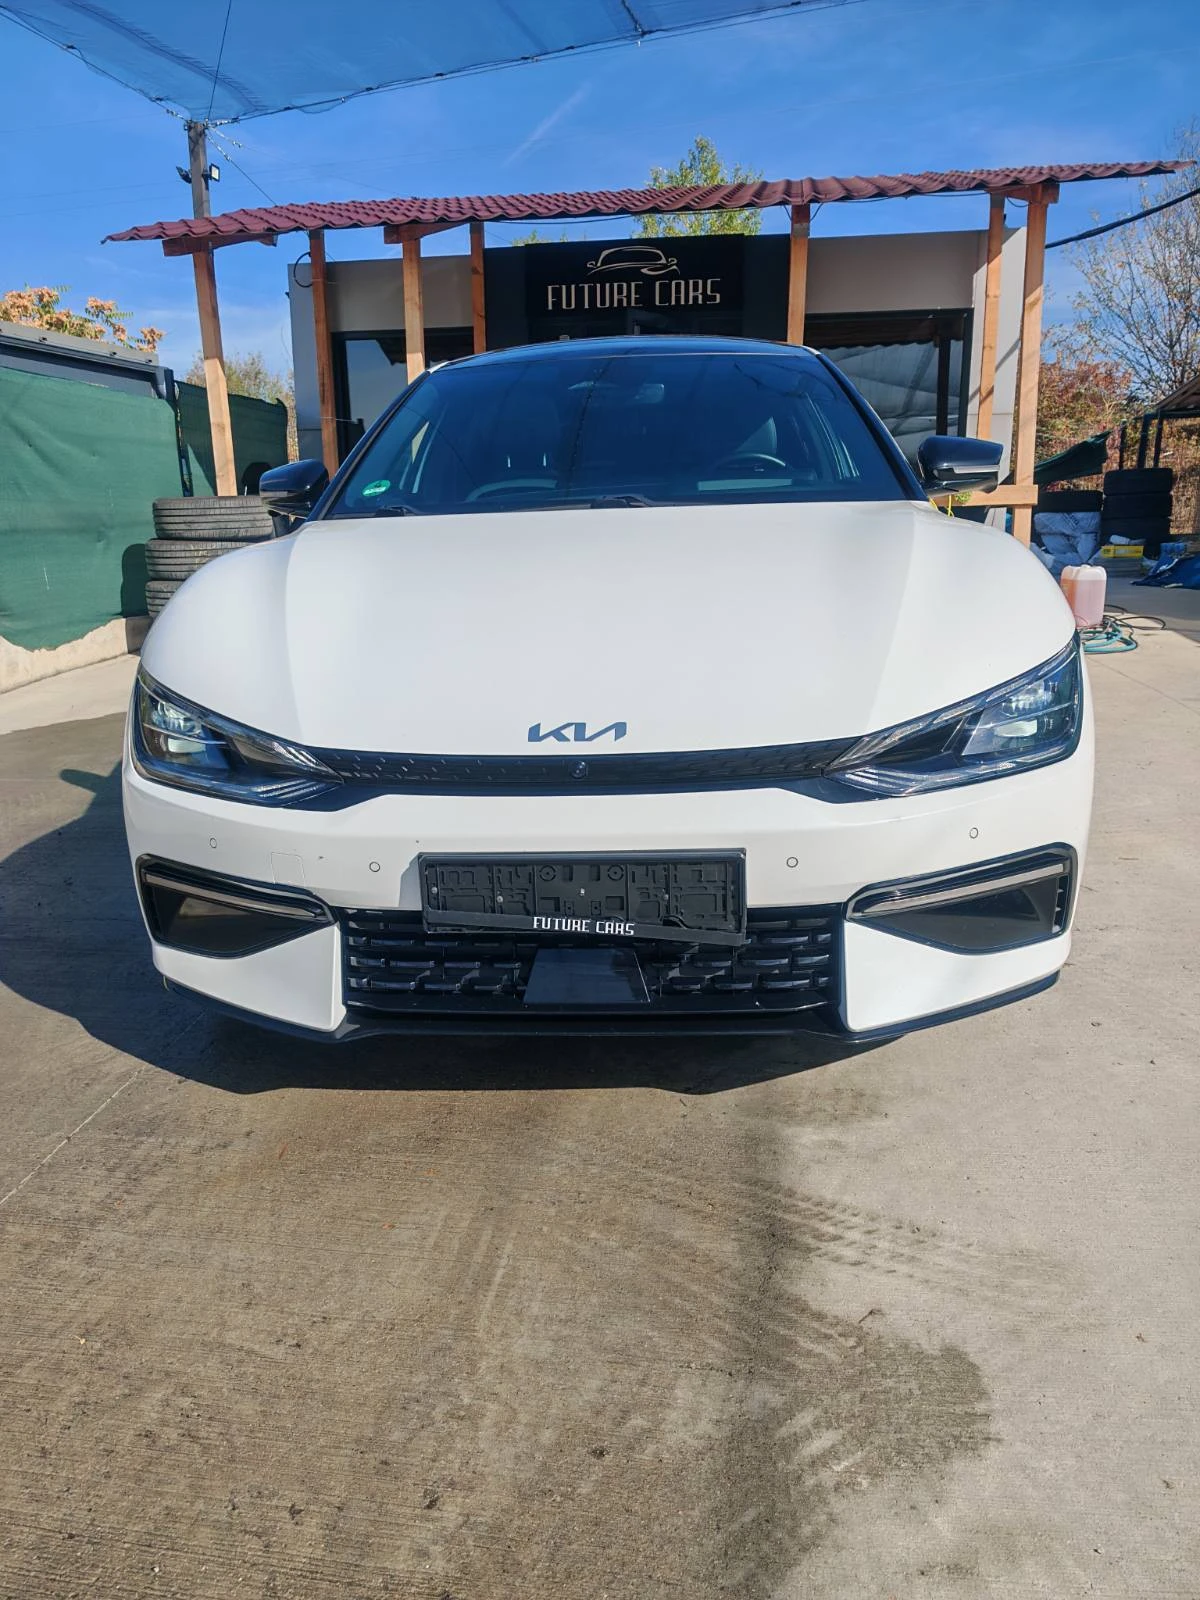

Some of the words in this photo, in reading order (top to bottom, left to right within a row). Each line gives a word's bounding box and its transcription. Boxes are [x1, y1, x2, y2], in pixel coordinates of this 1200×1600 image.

[547, 281, 643, 310] FUTURE
[655, 278, 721, 305] CARS
[533, 916, 590, 933] FUTURE
[595, 920, 635, 936] CARS
